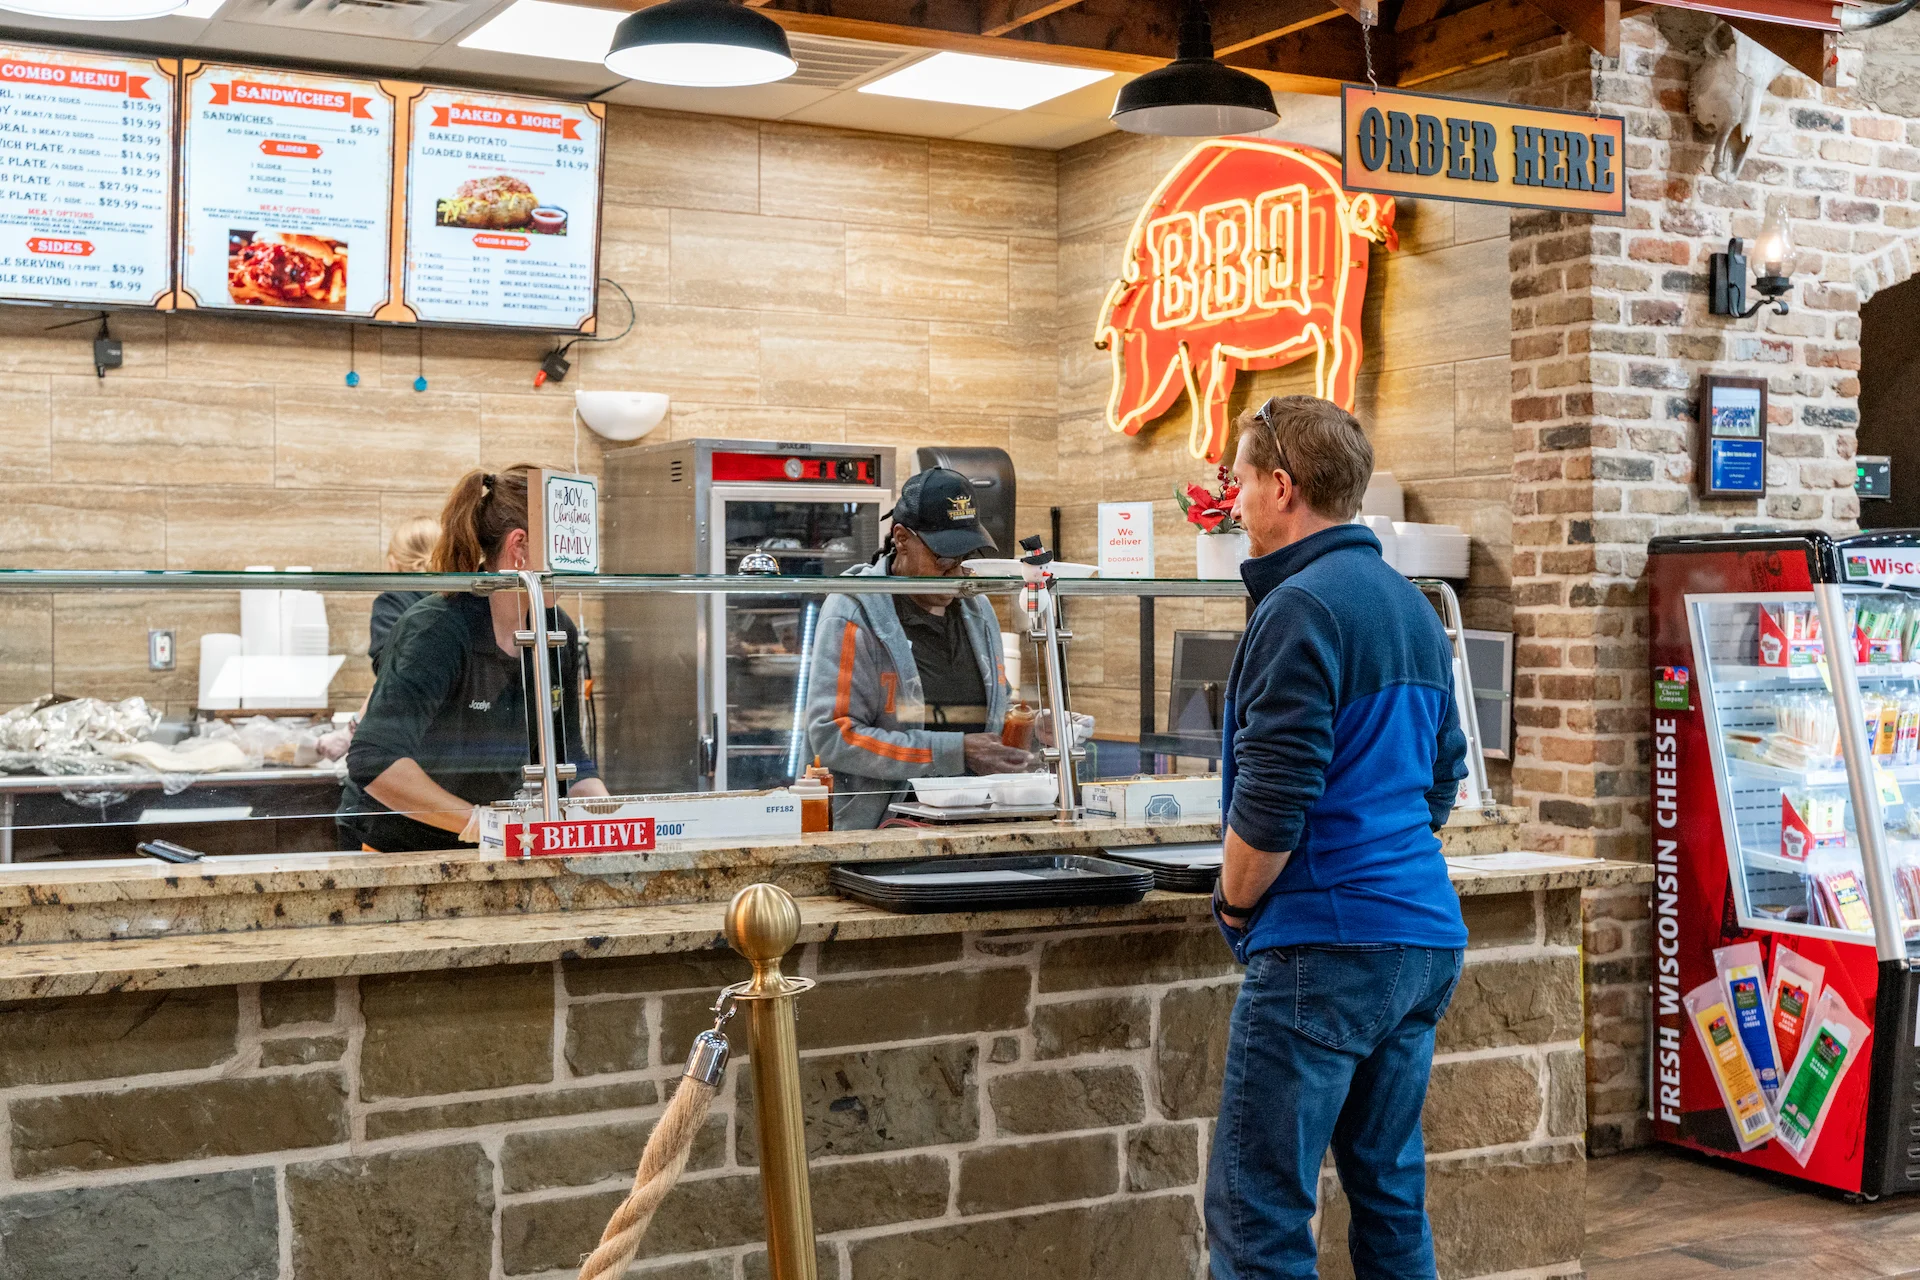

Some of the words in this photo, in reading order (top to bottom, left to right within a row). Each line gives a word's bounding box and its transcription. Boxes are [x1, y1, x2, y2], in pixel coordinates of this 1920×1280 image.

[2, 64, 65, 81] COMBO
[70, 71, 120, 87] MENU
[236, 86, 345, 107] SANDWICHES
[122, 100, 161, 113] $15.99
[122, 117, 161, 130] $19.99
[203, 111, 274, 125] SANDWICHES
[451, 108, 501, 123] BAKED
[506, 114, 517, 125] &
[521, 116, 561, 128] MORE
[122, 133, 161, 146] $23.99
[428, 132, 464, 143] BAKED
[467, 135, 507, 147] POTATO
[26, 142, 65, 153] PLATE
[121, 150, 161, 162] $14.99
[422, 146, 462, 158] LOADED
[465, 151, 506, 162] BARREL
[556, 159, 589, 171] $14.99
[1357, 106, 1499, 182] ORDER
[1512, 125, 1615, 193] HERE
[8, 157, 47, 169] PLATE
[122, 166, 161, 179] $12.99
[13, 174, 51, 186] PLATE
[99, 181, 138, 193] $27.99
[9, 190, 48, 202] PLATE
[99, 197, 138, 210] $29.99
[260, 204, 283, 212] MEAT
[286, 206, 321, 214] OPTIONS
[56, 210, 95, 219] OPTIONS
[38, 240, 83, 253] SIDES
[15, 258, 65, 269] SERVING
[1146, 183, 1311, 330] BBQ
[21, 275, 71, 286] SERVING
[564, 486, 583, 507] JOY
[553, 502, 590, 524] Christmas
[1110, 537, 1142, 545] deliver
[1117, 528, 1134, 536] We
[554, 534, 591, 555] FAMILY
[1659, 695, 1683, 703] Company
[1656, 718, 1677, 829] CHEESE
[766, 805, 794, 813] EFF182
[541, 821, 648, 851] BELIEVE
[1657, 840, 1680, 1015] WISCONSIN
[1742, 1009, 1757, 1017] COLBY
[1660, 1026, 1681, 1125] FRESH
